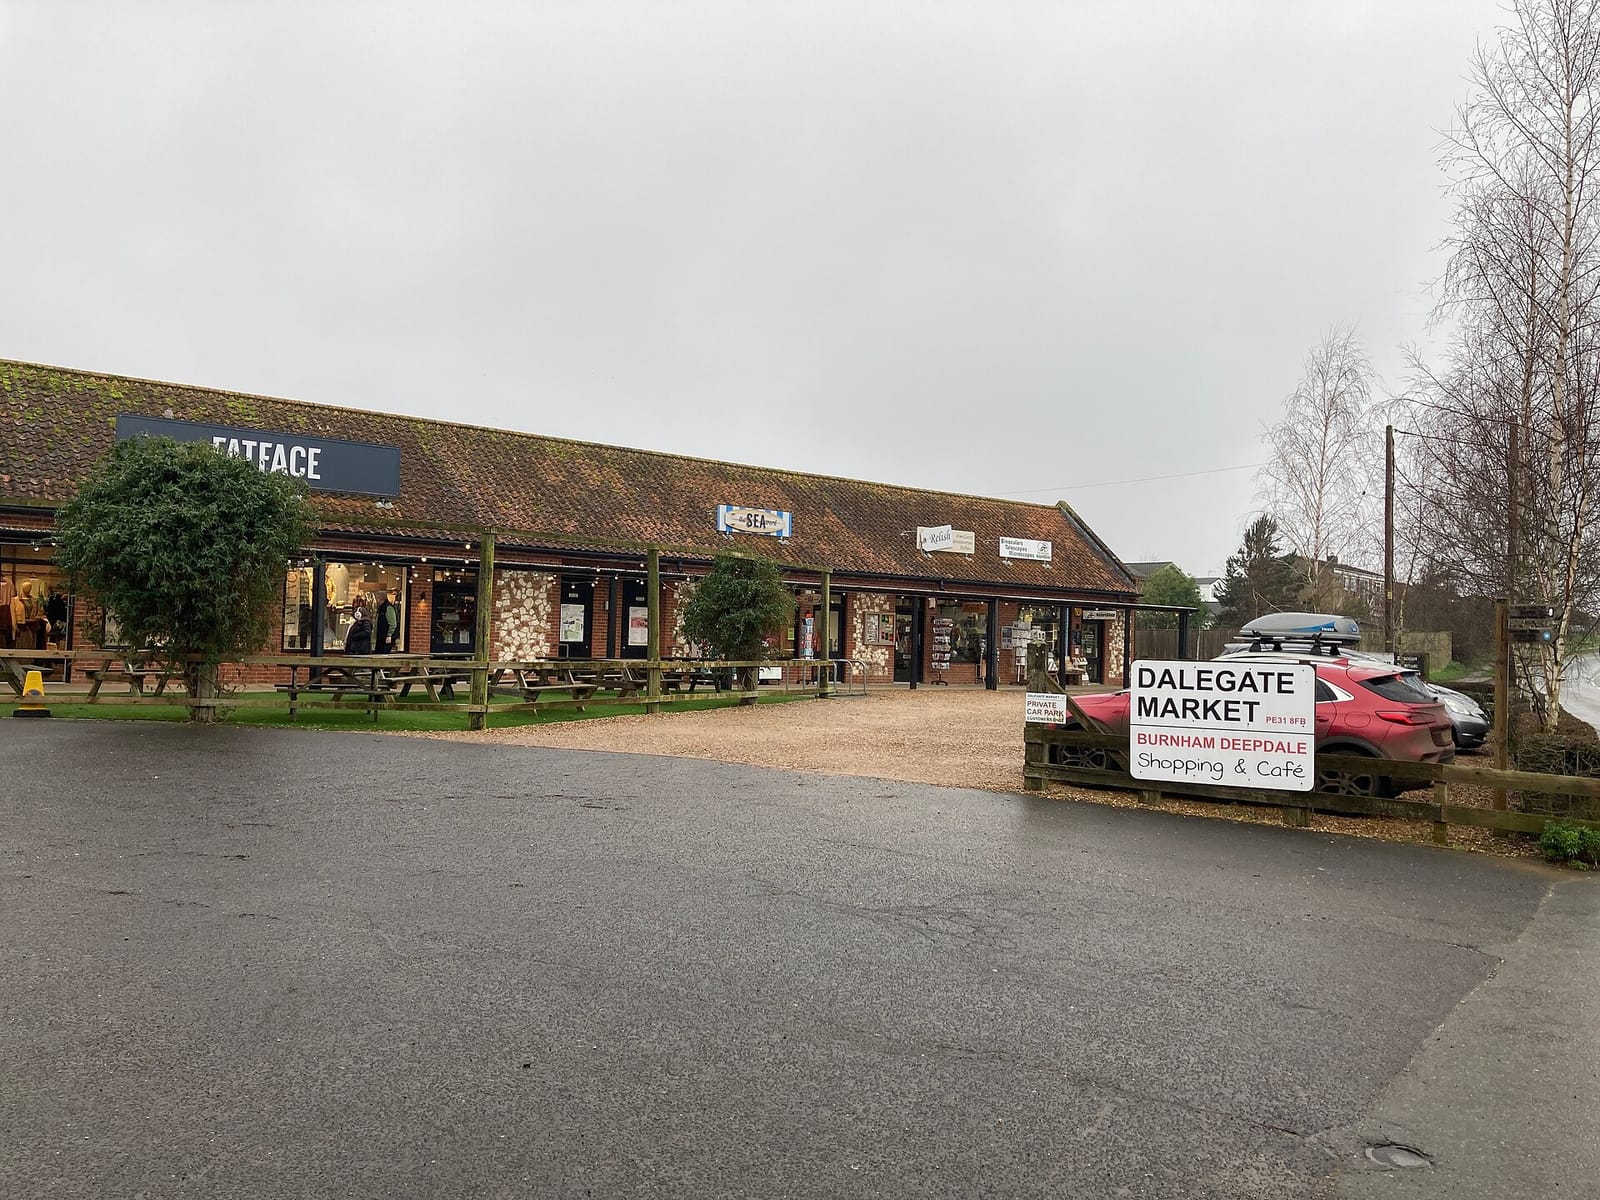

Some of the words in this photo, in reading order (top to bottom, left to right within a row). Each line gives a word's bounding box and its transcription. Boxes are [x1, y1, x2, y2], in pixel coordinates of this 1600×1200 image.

[746, 513, 766, 529] SEA
[930, 529, 951, 545] Relish
[1138, 667, 1295, 695] DALEGATE
[1026, 700, 1057, 709] PRIVATE
[1137, 696, 1261, 723] MARKET
[1026, 708, 1043, 716] CAR
[1044, 710, 1064, 719] PARK
[1265, 716, 1287, 725] PE31
[1289, 717, 1307, 726] 8FB
[1137, 733, 1216, 750] BURNHAM
[1220, 738, 1308, 755] DEEPDALE
[1137, 752, 1224, 781] Shopping
[1234, 758, 1247, 775] &
[1256, 760, 1306, 779] Café
